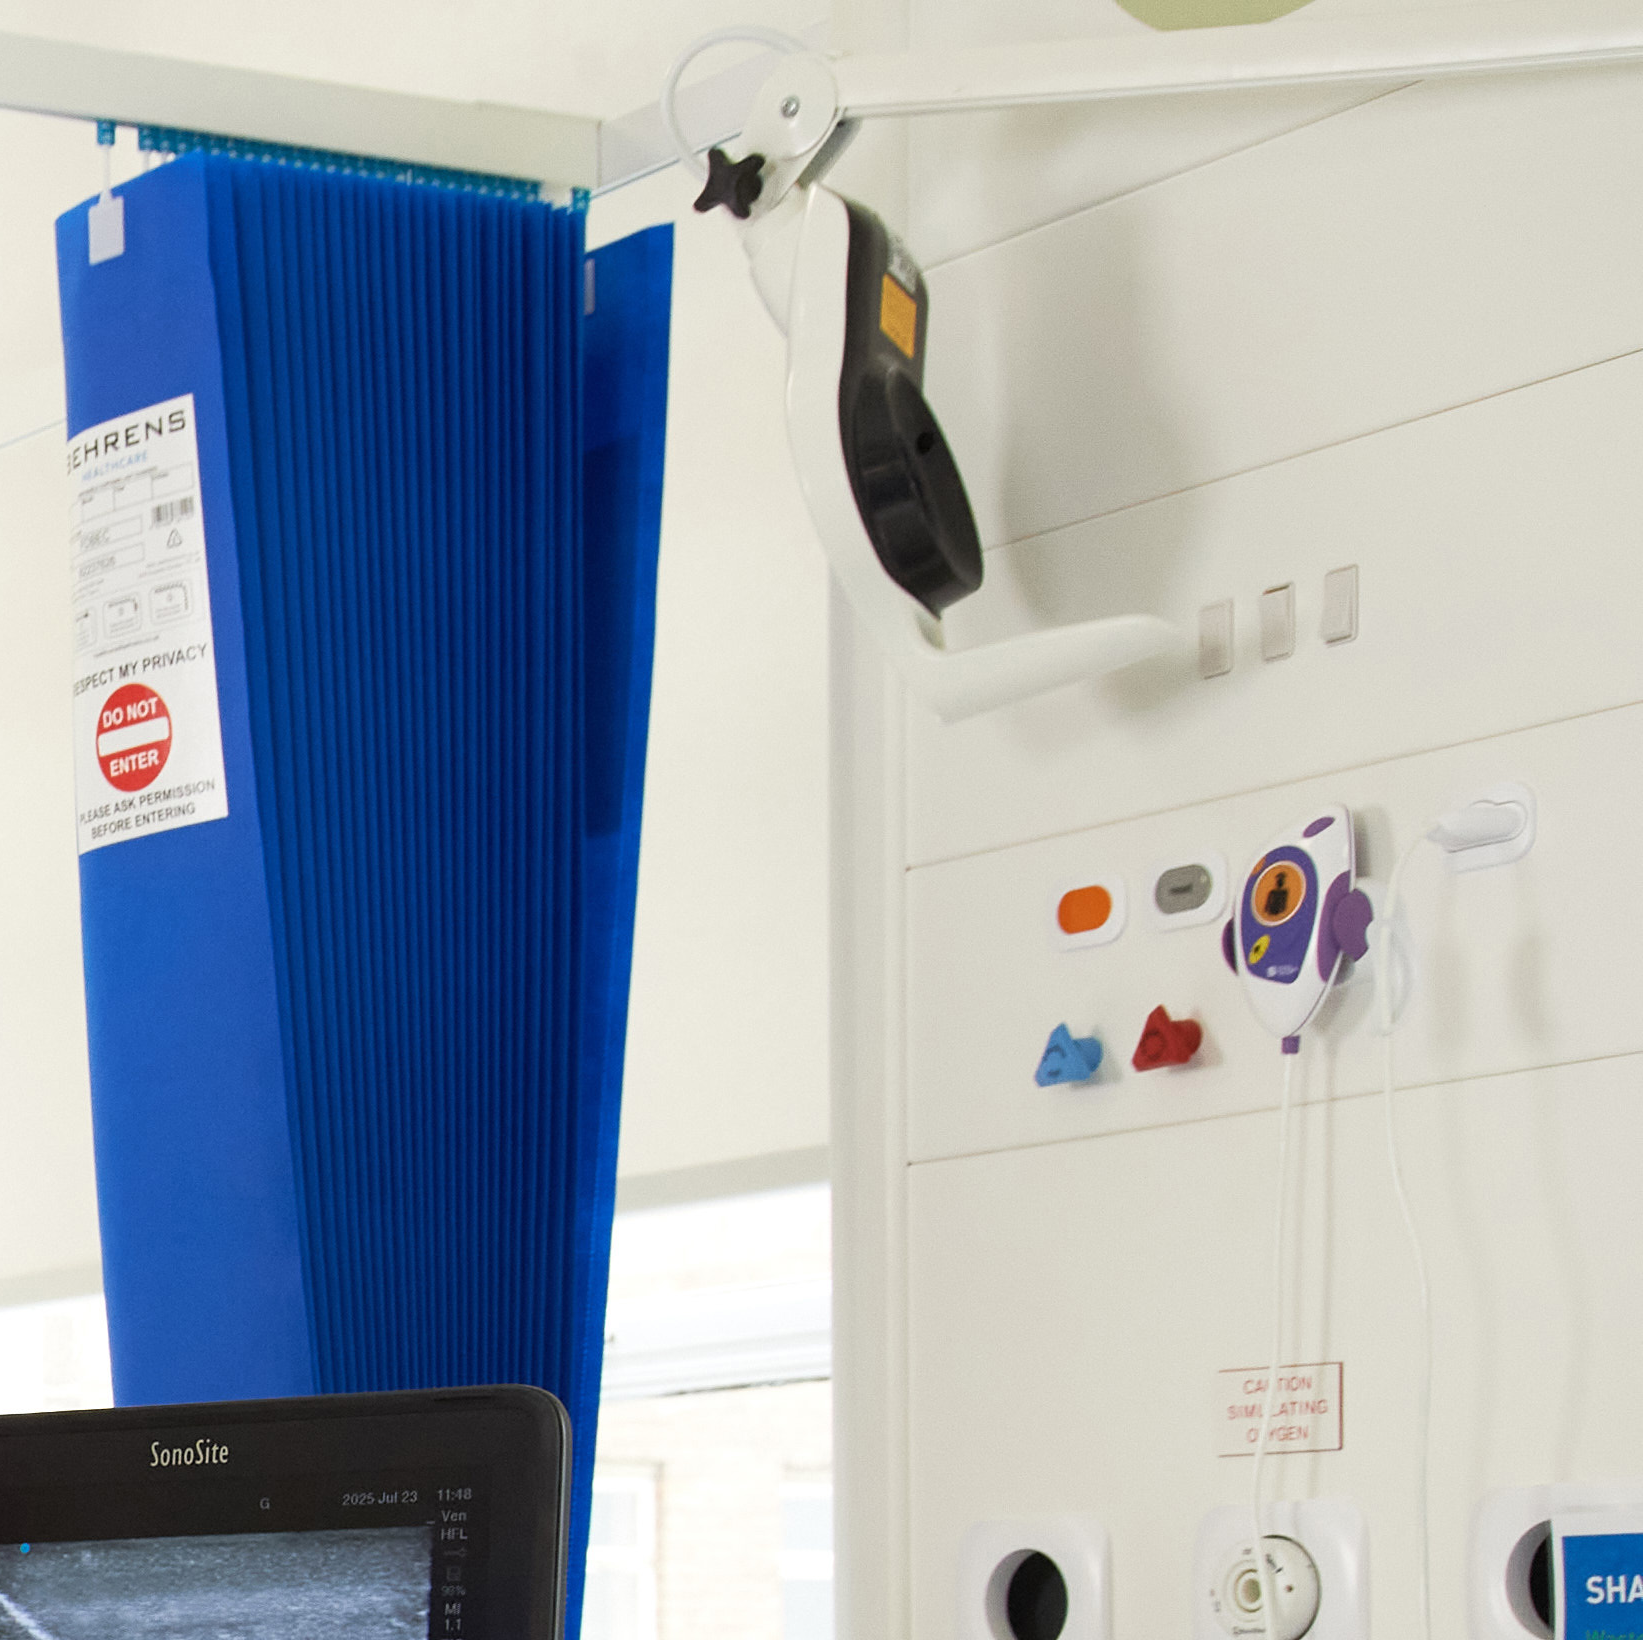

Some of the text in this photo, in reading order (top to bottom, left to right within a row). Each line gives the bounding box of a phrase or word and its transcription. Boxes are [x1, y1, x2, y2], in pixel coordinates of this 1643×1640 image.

[67, 410, 186, 475] EHRENS
[73, 668, 115, 696] ESPECT
[118, 660, 139, 679] MY
[141, 644, 207, 673] PRIVACY
[102, 697, 158, 729] DO NOT
[109, 748, 159, 777] ENTER
[80, 778, 215, 825] PLEASE ASK PERMISSION
[91, 802, 195, 839] BEFORE ENTERING
[1227, 1399, 1328, 1420] SIMATING
[1246, 1425, 1309, 1443] OYGEN
[149, 1438, 229, 1467] SonoSite
[342, 1488, 473, 1507] 2025 Jul 23 11:48
[440, 1510, 468, 1522] Ven
